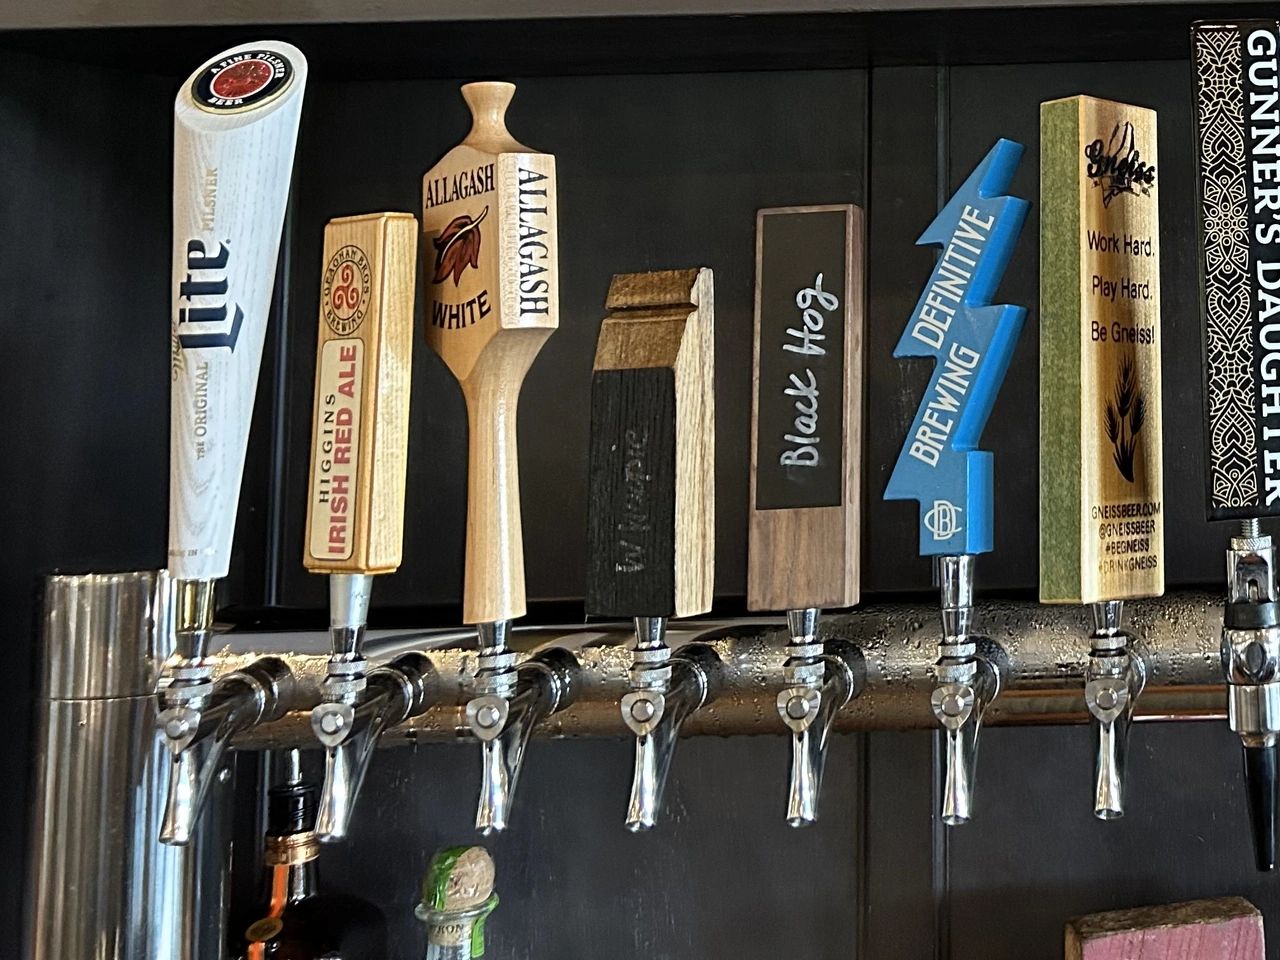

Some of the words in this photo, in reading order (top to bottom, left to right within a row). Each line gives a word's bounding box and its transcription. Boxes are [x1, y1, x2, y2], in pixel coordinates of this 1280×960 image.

[220, 53, 252, 67] FINE
[256, 51, 286, 79] PILSNER
[207, 96, 244, 106] BEER
[1084, 139, 1156, 185] Gneiss
[202, 167, 218, 232] PILSNER
[426, 163, 495, 209] ALLAGASH
[518, 167, 549, 317] ALLAGASH
[1087, 229, 1120, 254] Work
[1123, 234, 1155, 258] Hard.
[179, 239, 245, 354] Lite
[358, 256, 370, 294] BROS
[911, 204, 995, 351] DEFINITIVE
[1092, 275, 1118, 303] Play
[1121, 276, 1153, 301] Hard.
[326, 309, 364, 333] BREWING
[432, 289, 492, 330] WHITE
[782, 272, 839, 356] Hog
[1091, 320, 1108, 342] Be
[1111, 321, 1156, 345] Gneiss!
[339, 344, 357, 399] ALE
[194, 361, 209, 433] ORIGINAL
[780, 368, 819, 467] Black
[908, 342, 981, 469] BREWING
[319, 393, 336, 504] HIGGINS
[334, 407, 354, 465] RED
[328, 474, 350, 555] IRISH
[1092, 502, 1161, 520] GNEISSBEER.COM
[1098, 519, 1156, 540] @GNEISSBEER
[1098, 555, 1158, 575] #DRINKGNEISS
[1105, 538, 1150, 555] #BEGNEISS
